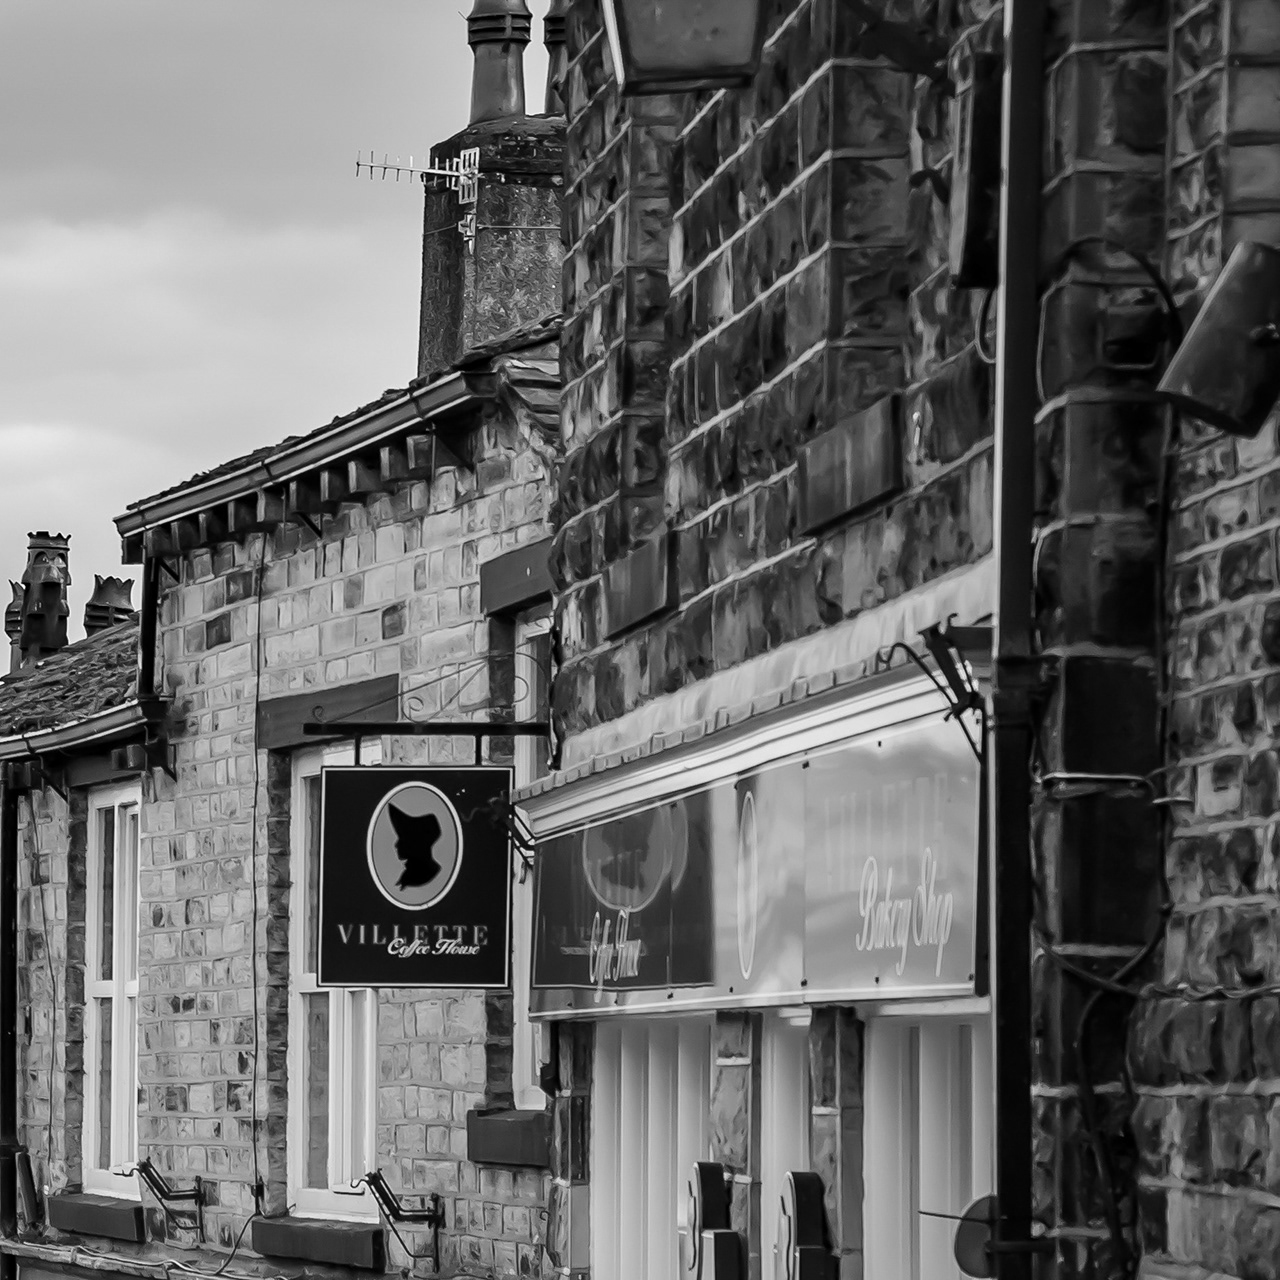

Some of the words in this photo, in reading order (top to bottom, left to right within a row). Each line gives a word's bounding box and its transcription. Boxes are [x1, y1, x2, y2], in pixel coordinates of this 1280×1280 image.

[912, 847, 954, 977] Shop
[337, 923, 489, 946] VILLETTE
[387, 937, 431, 958] Coffee
[431, 938, 481, 956] House
